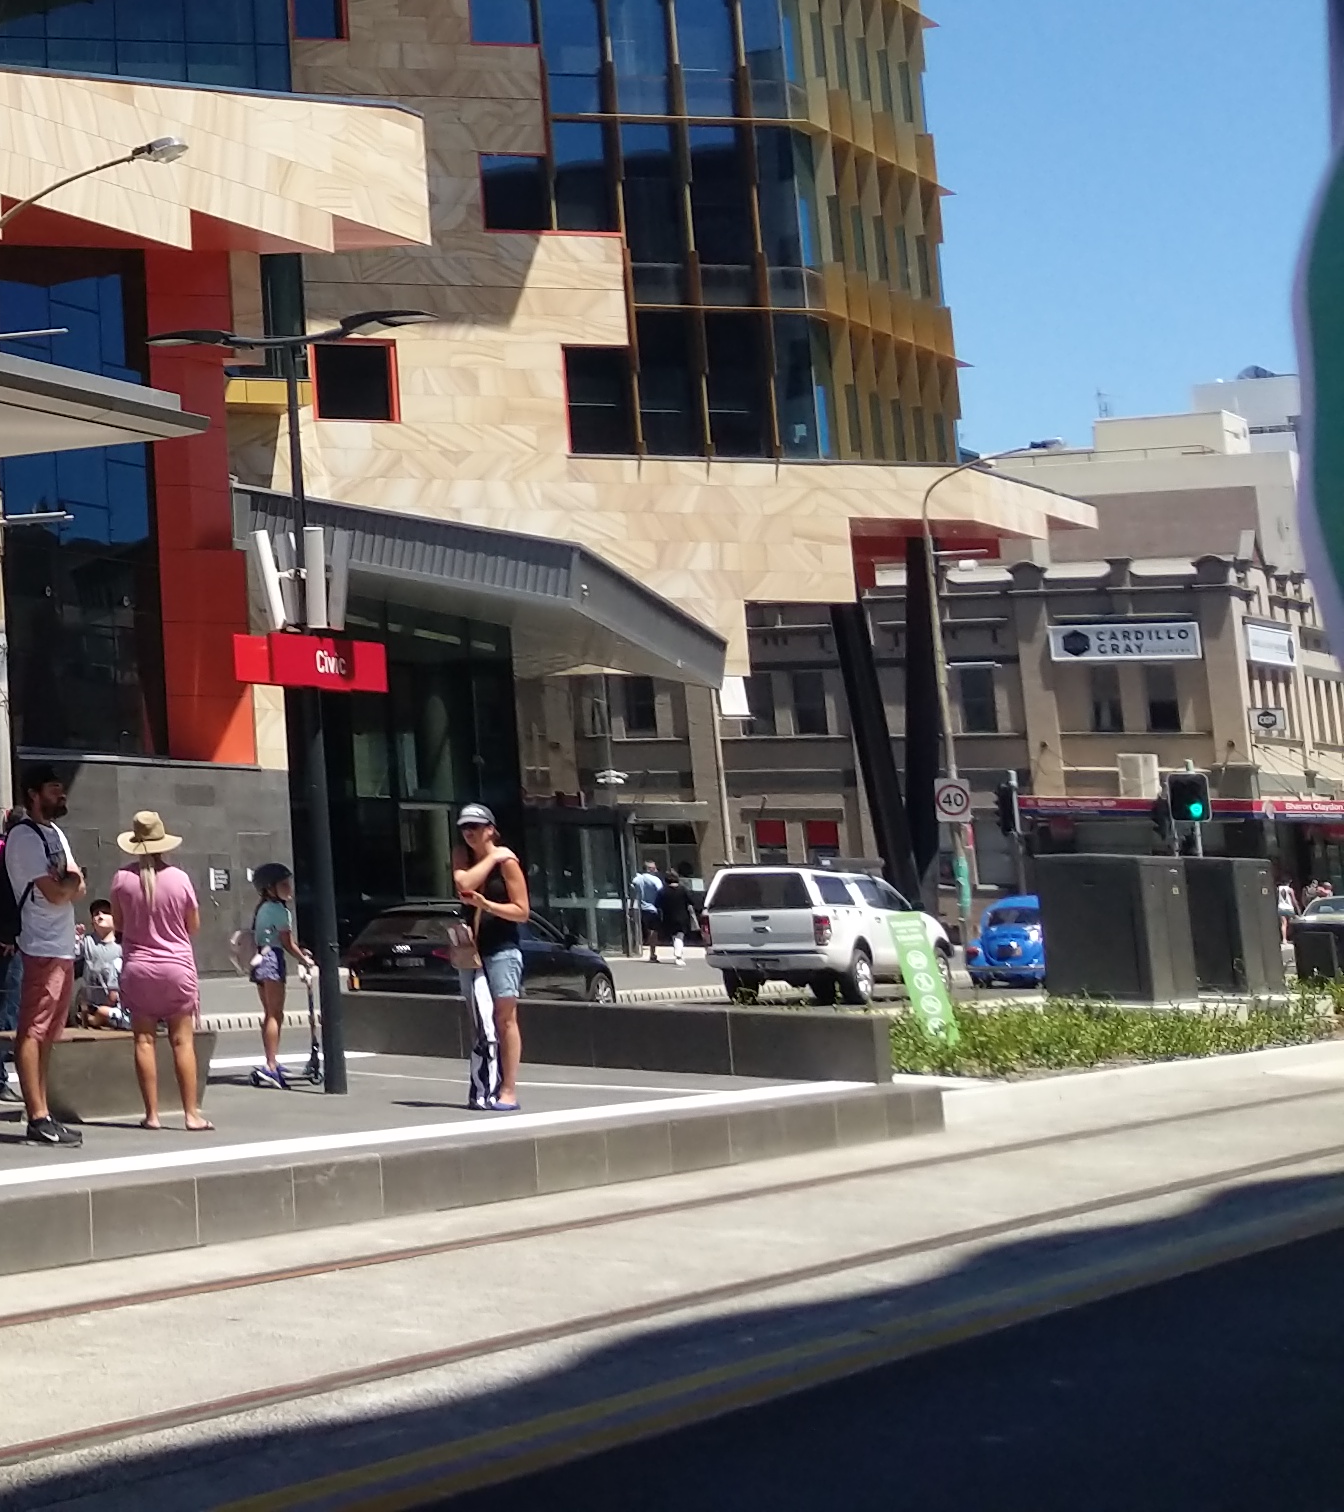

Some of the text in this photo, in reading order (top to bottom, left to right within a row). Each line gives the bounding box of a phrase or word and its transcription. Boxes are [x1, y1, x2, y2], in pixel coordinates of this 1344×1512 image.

[1096, 628, 1189, 642] CARDILLO
[1098, 642, 1145, 655] GRAY
[315, 650, 347, 676] Civic
[942, 791, 965, 809] 40
